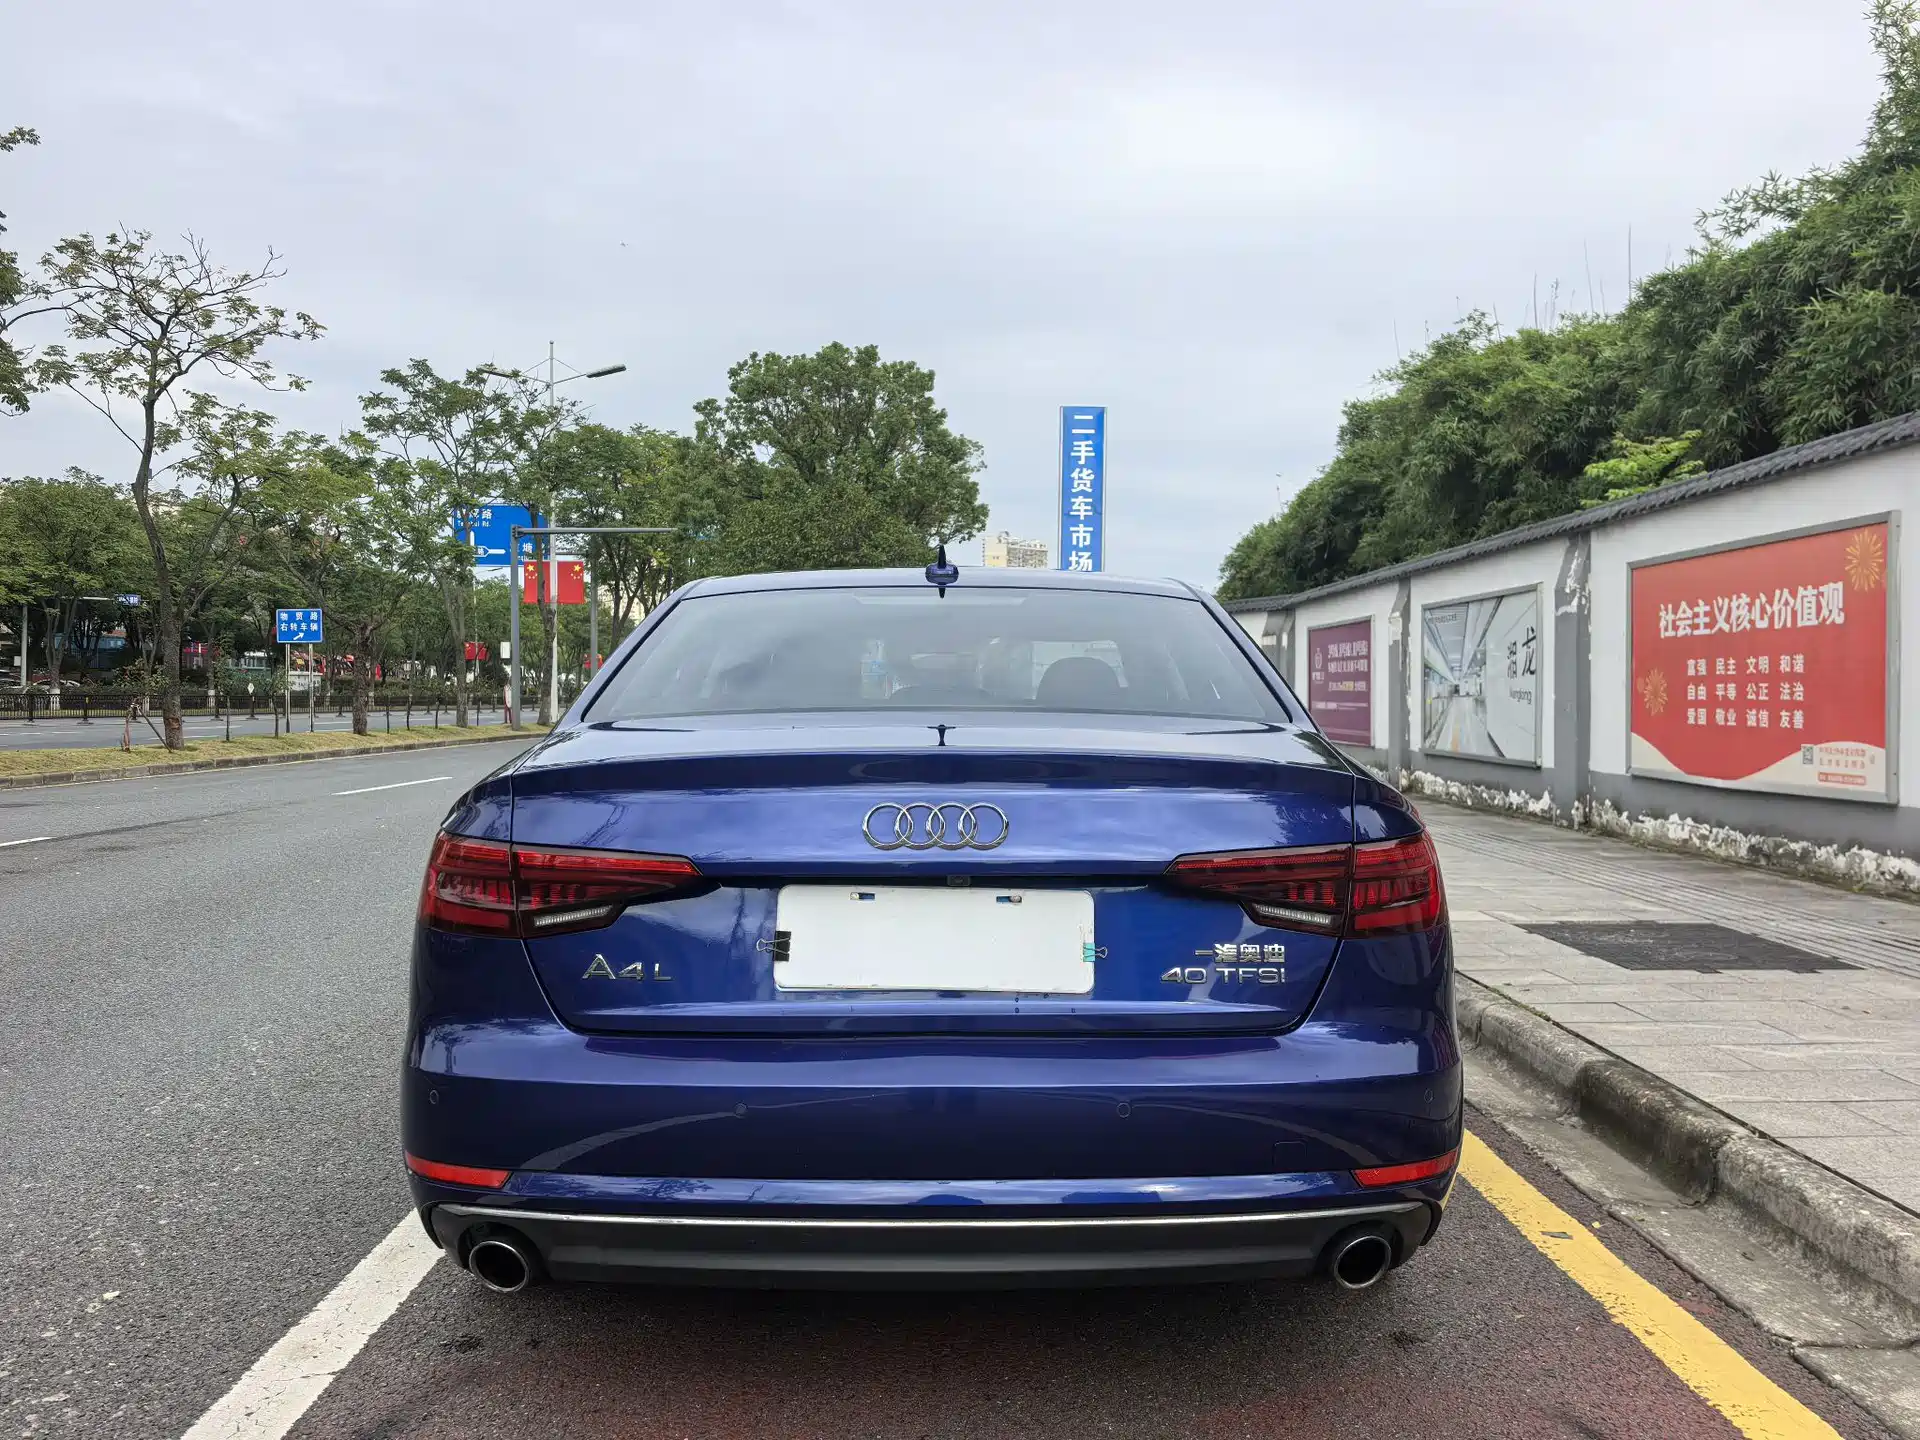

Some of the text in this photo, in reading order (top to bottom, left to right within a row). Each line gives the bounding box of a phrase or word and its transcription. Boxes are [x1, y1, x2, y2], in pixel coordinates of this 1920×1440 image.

[1068, 414, 1096, 572] 二手货车市场
[280, 611, 318, 621] 物贸路
[1659, 581, 1845, 639] 社会主义核心价值观
[280, 622, 318, 632] 右转车辆
[1687, 654, 1805, 676] 富强 民主 文明 和谐
[1687, 682, 1805, 702] 自由 平等 公正 法治
[1687, 708, 1805, 729] 爱国 敬业 诚信 友善
[1161, 967, 1207, 983] 40
